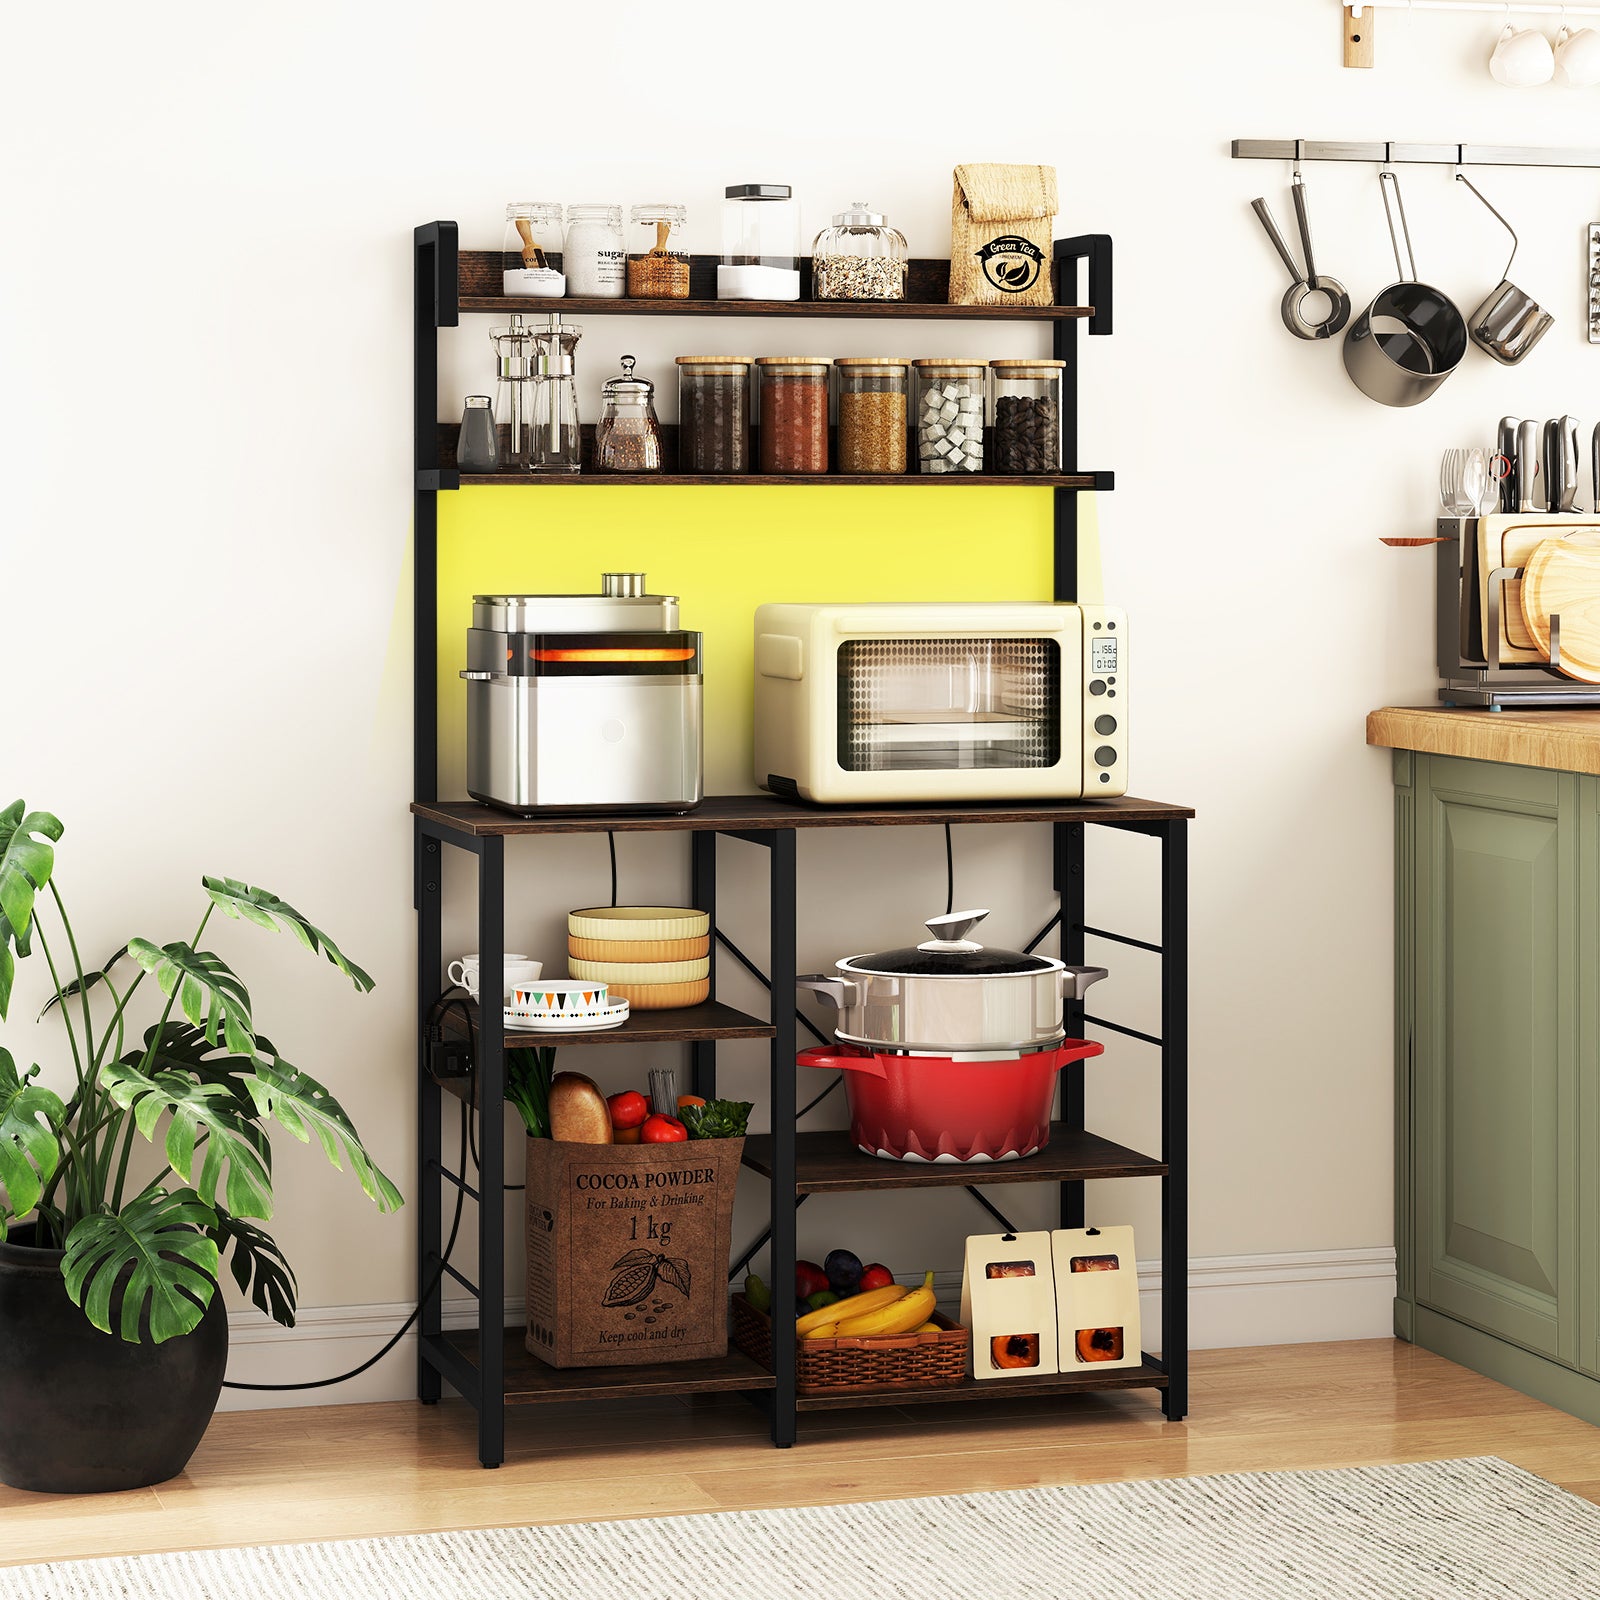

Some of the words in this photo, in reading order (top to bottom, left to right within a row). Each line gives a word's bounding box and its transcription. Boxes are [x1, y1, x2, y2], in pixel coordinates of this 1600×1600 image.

[653, 250, 684, 260] sugar
[990, 242, 1016, 253] Green
[1019, 242, 1035, 256] Tea
[576, 1174, 640, 1190] COCOA
[644, 1168, 714, 1189] POWDER
[586, 1197, 607, 1210] For
[609, 1196, 647, 1212] Baking
[649, 1195, 658, 1208] &
[660, 1192, 705, 1207] Drinking
[629, 1215, 638, 1241] 1
[646, 1214, 673, 1247] kg
[598, 1330, 625, 1346] Keep
[626, 1327, 648, 1342] cool
[649, 1325, 669, 1340] and
[670, 1325, 687, 1341] dry
